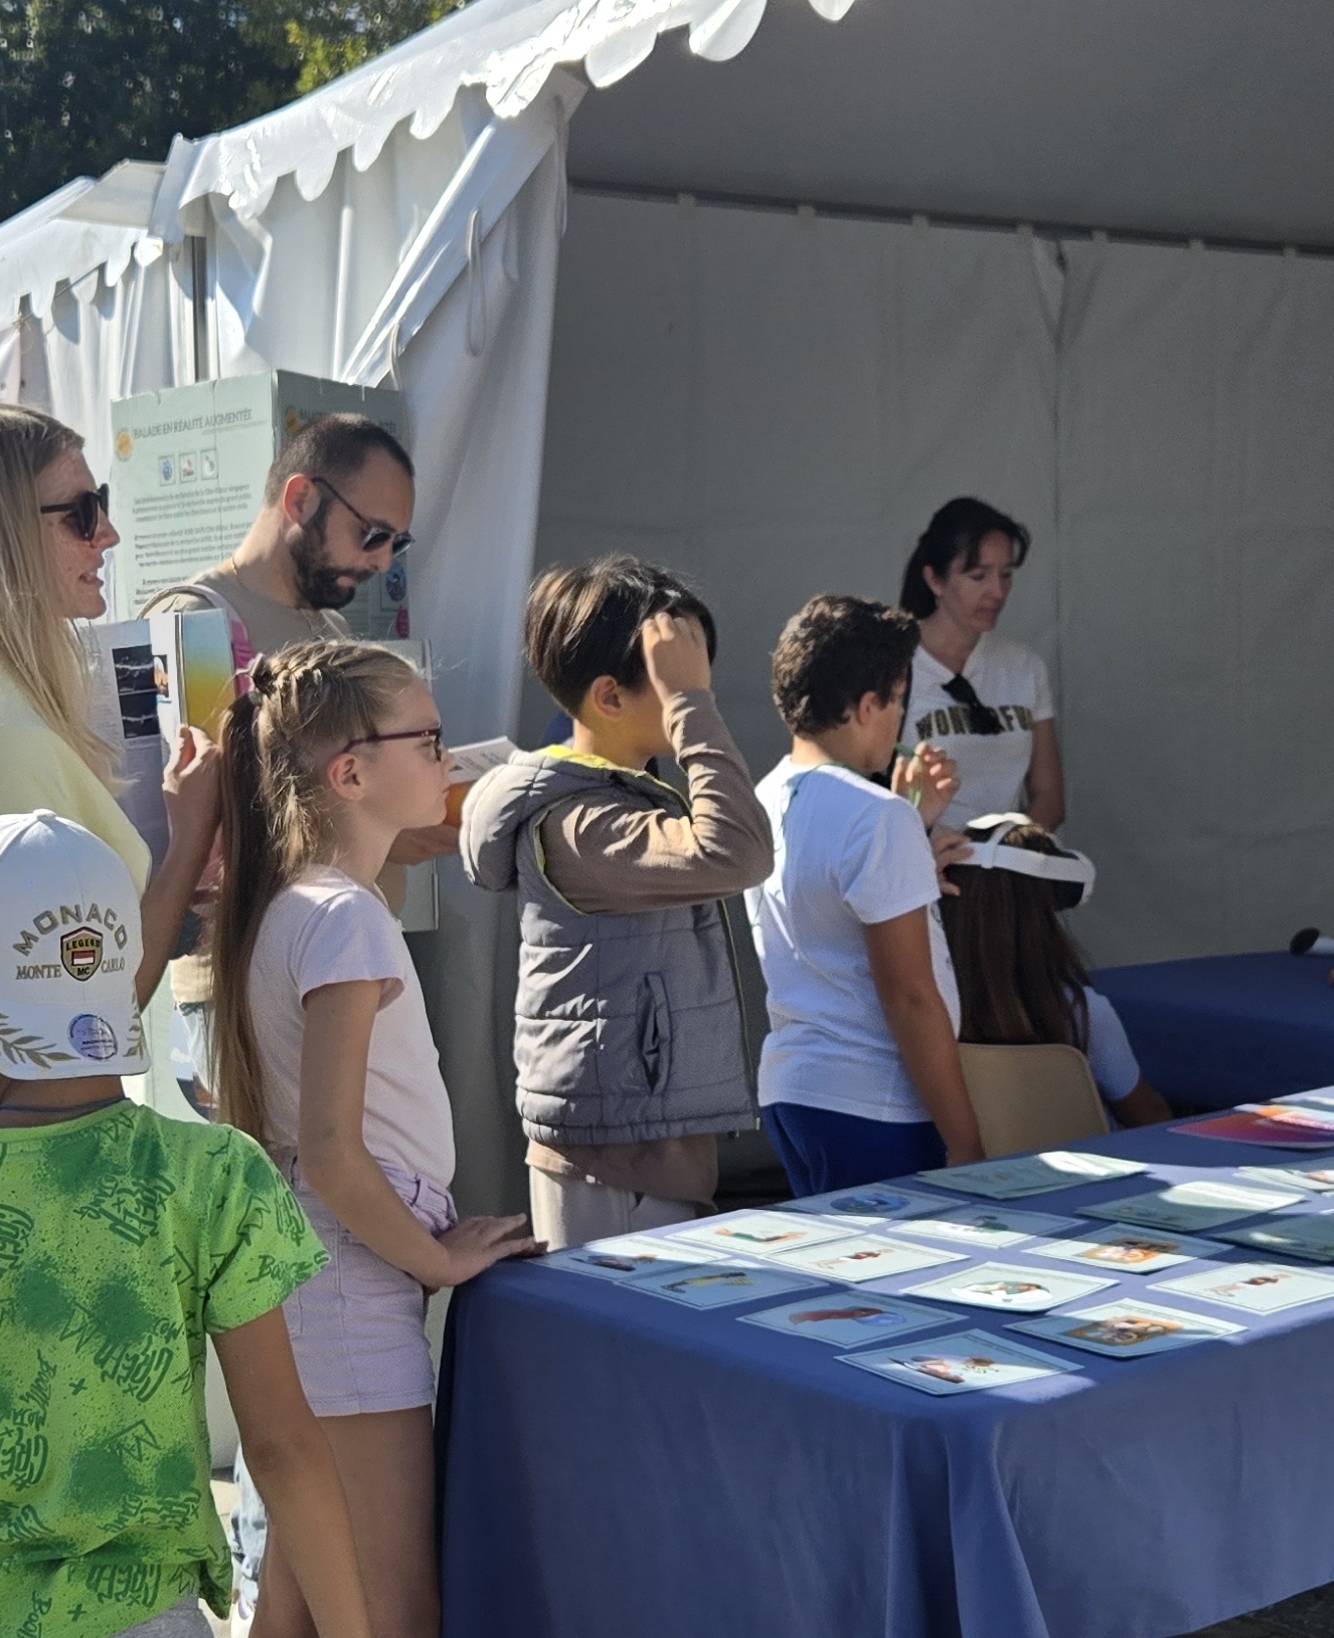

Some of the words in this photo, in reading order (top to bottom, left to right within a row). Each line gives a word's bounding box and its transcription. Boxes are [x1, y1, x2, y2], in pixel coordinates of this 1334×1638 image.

[12, 903, 128, 956] MONACO
[16, 964, 62, 980] MONTE
[101, 957, 125, 973] CARLO
[77, 967, 90, 976] MC
